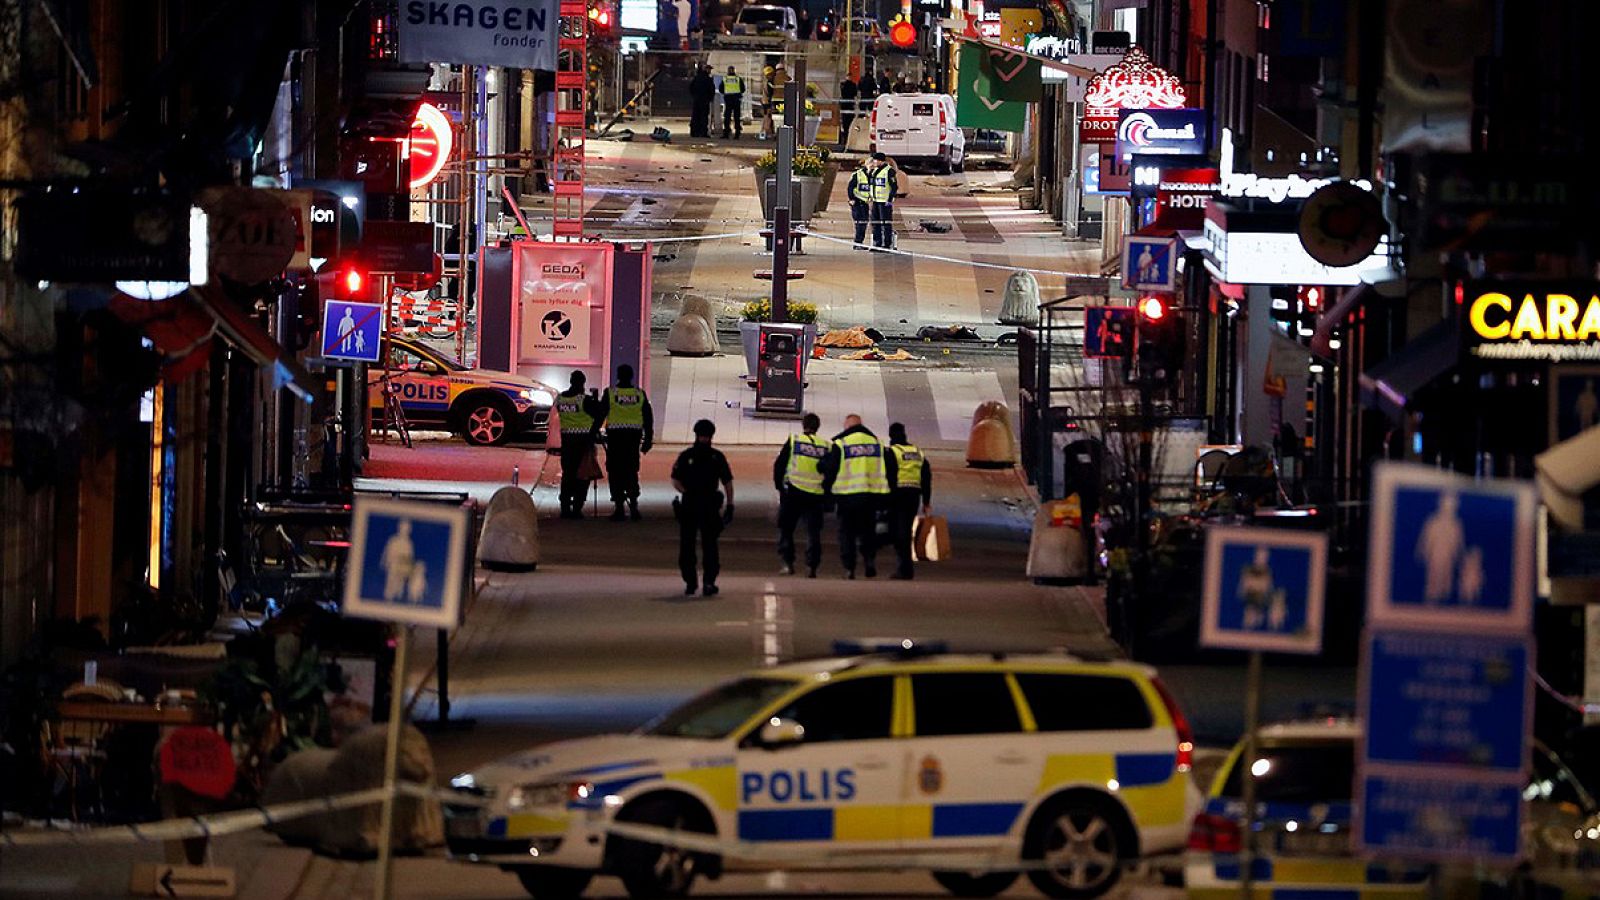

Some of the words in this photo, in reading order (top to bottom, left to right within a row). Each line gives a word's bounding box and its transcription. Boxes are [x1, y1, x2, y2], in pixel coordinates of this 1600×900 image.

[407, 1, 546, 31] SKAGEN
[493, 33, 545, 48] fonder
[1470, 292, 1600, 339] CARA
[392, 382, 448, 400] POLIS
[741, 768, 857, 803] POLIS
